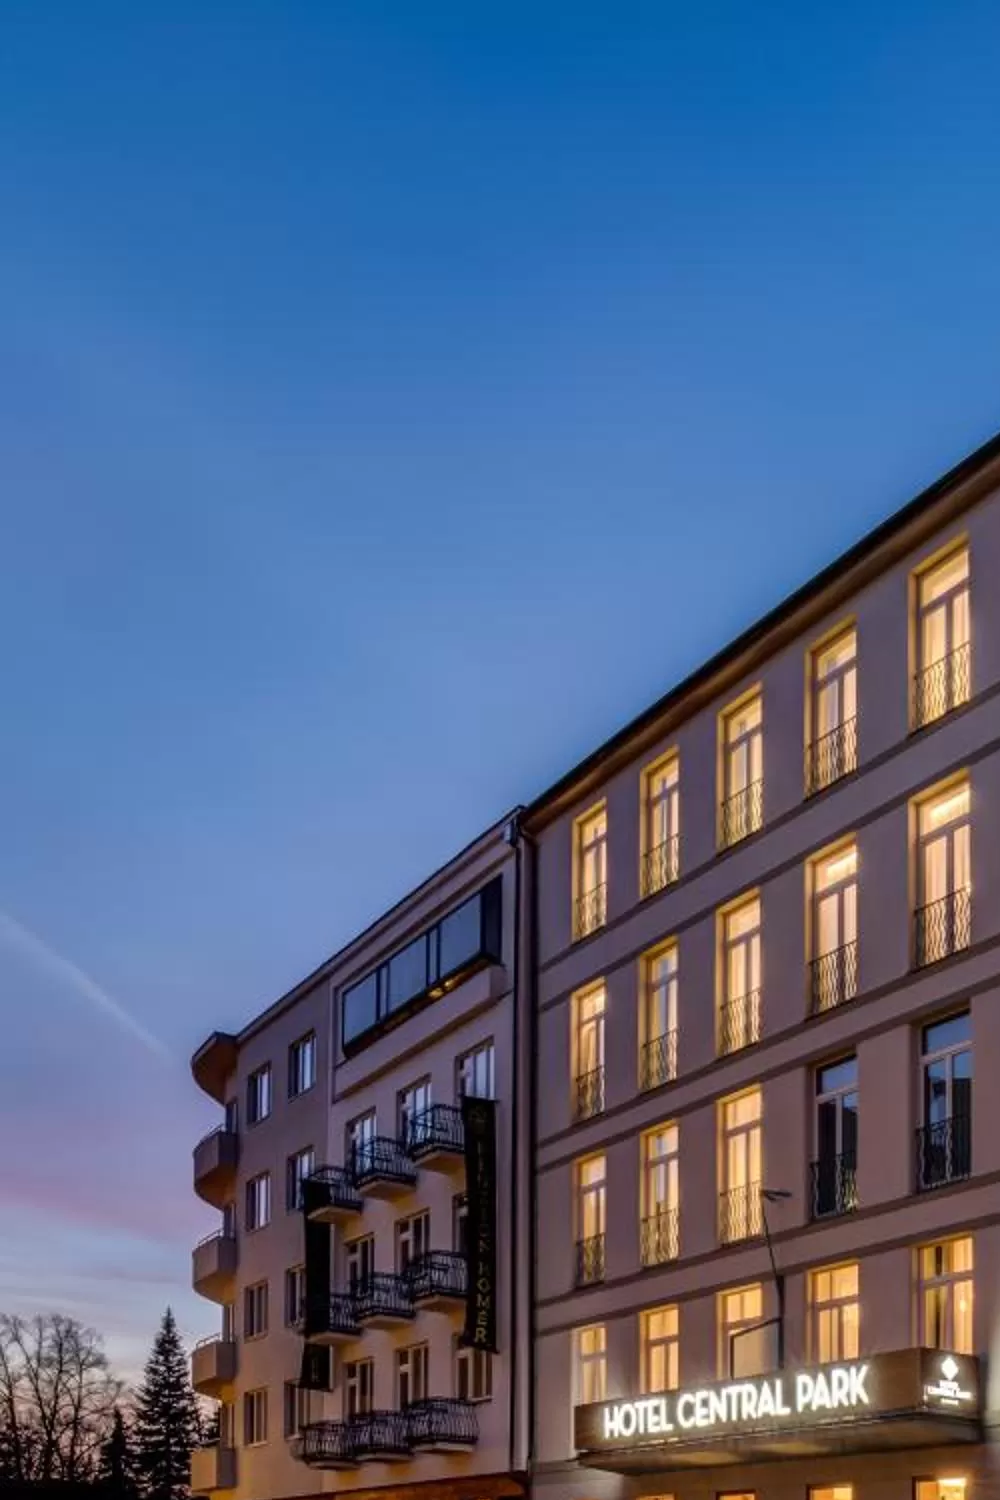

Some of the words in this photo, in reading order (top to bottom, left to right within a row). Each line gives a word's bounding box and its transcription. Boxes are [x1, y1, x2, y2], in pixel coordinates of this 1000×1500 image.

[472, 1261, 492, 1344] HOMER
[603, 1398, 675, 1440] HOTEL
[676, 1378, 791, 1429] CENTRAL
[795, 1364, 870, 1414] PARK
